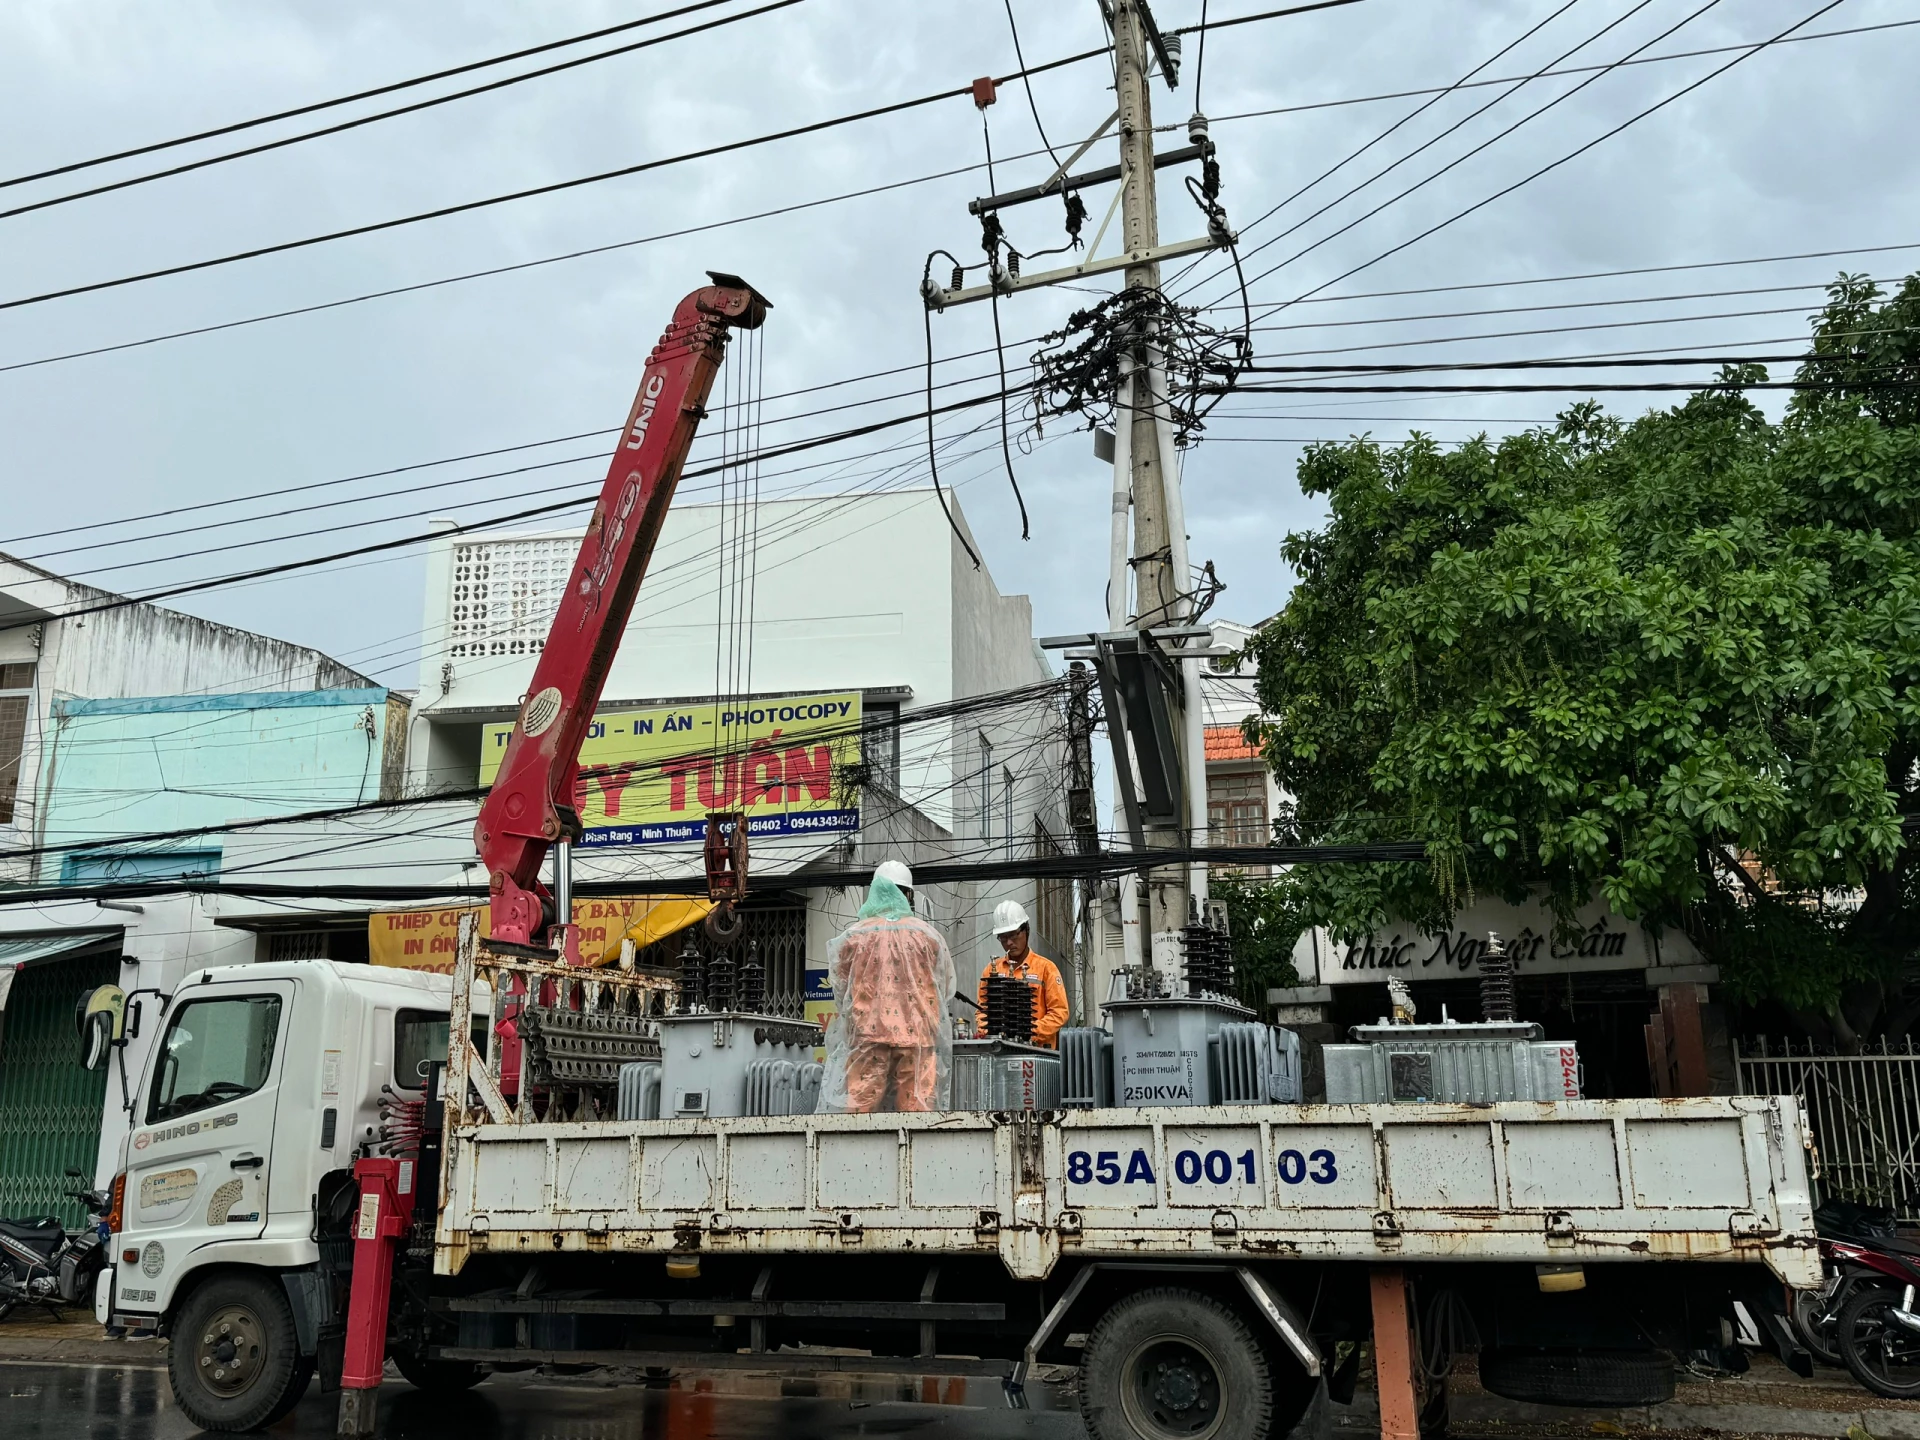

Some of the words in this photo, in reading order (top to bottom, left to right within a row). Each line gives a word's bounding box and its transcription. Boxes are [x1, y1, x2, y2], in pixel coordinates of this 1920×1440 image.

[627, 375, 665, 451] UNIC
[633, 719, 653, 736] IN
[662, 711, 693, 733] ẤN
[722, 701, 852, 727] PHOTOCOPY
[660, 729, 831, 812] TUẤN
[609, 830, 633, 842] Rang
[641, 828, 663, 840] Ninh
[664, 826, 692, 839] Thuận
[590, 902, 635, 919] BAY
[386, 912, 433, 932] THIỆP
[404, 938, 424, 955] IN
[430, 932, 457, 954] ẤN
[805, 991, 834, 999] Vietnam
[1126, 1067, 1136, 1075] PC
[1137, 1067, 1155, 1075] NINH
[1156, 1065, 1181, 1075] THUẬN
[1559, 1047, 1579, 1098] 22440
[1125, 1085, 1189, 1101] 250KVA
[1067, 1149, 1156, 1185] 85A
[1175, 1149, 1256, 1185] 001
[1278, 1149, 1338, 1185] 03
[153, 1178, 166, 1186] EVN
